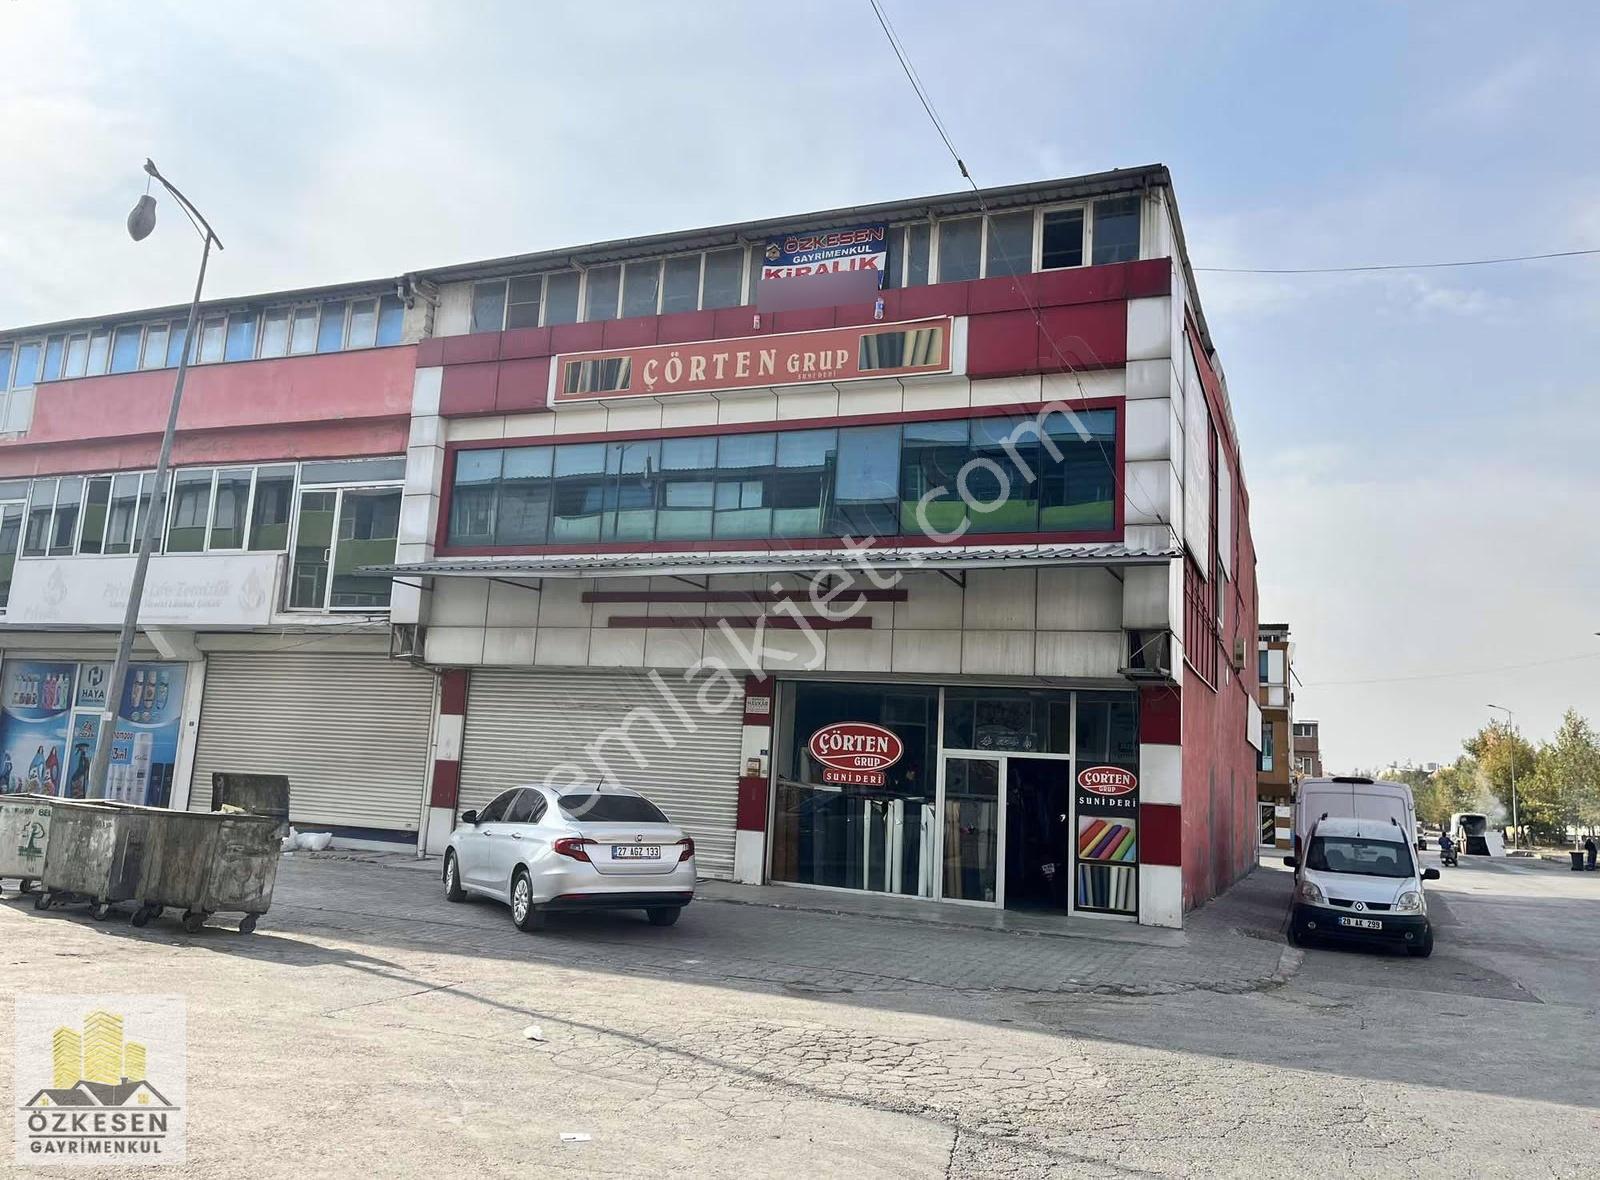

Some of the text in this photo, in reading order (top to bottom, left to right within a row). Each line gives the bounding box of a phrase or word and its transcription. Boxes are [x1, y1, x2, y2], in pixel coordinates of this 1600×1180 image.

[784, 227, 884, 253] ÖZKESEN
[793, 245, 872, 263] GAYRİMENKUL
[643, 350, 849, 391] ÇÖRTEN GRUP
[82, 689, 104, 698] HAYA
[819, 730, 889, 754] ÇÖRTEN
[854, 757, 881, 766] GRUP
[826, 772, 882, 784] SUNİ DERİ
[1079, 796, 1136, 807] SUNİ DERİ
[618, 847, 659, 856] 27 AGZ 133
